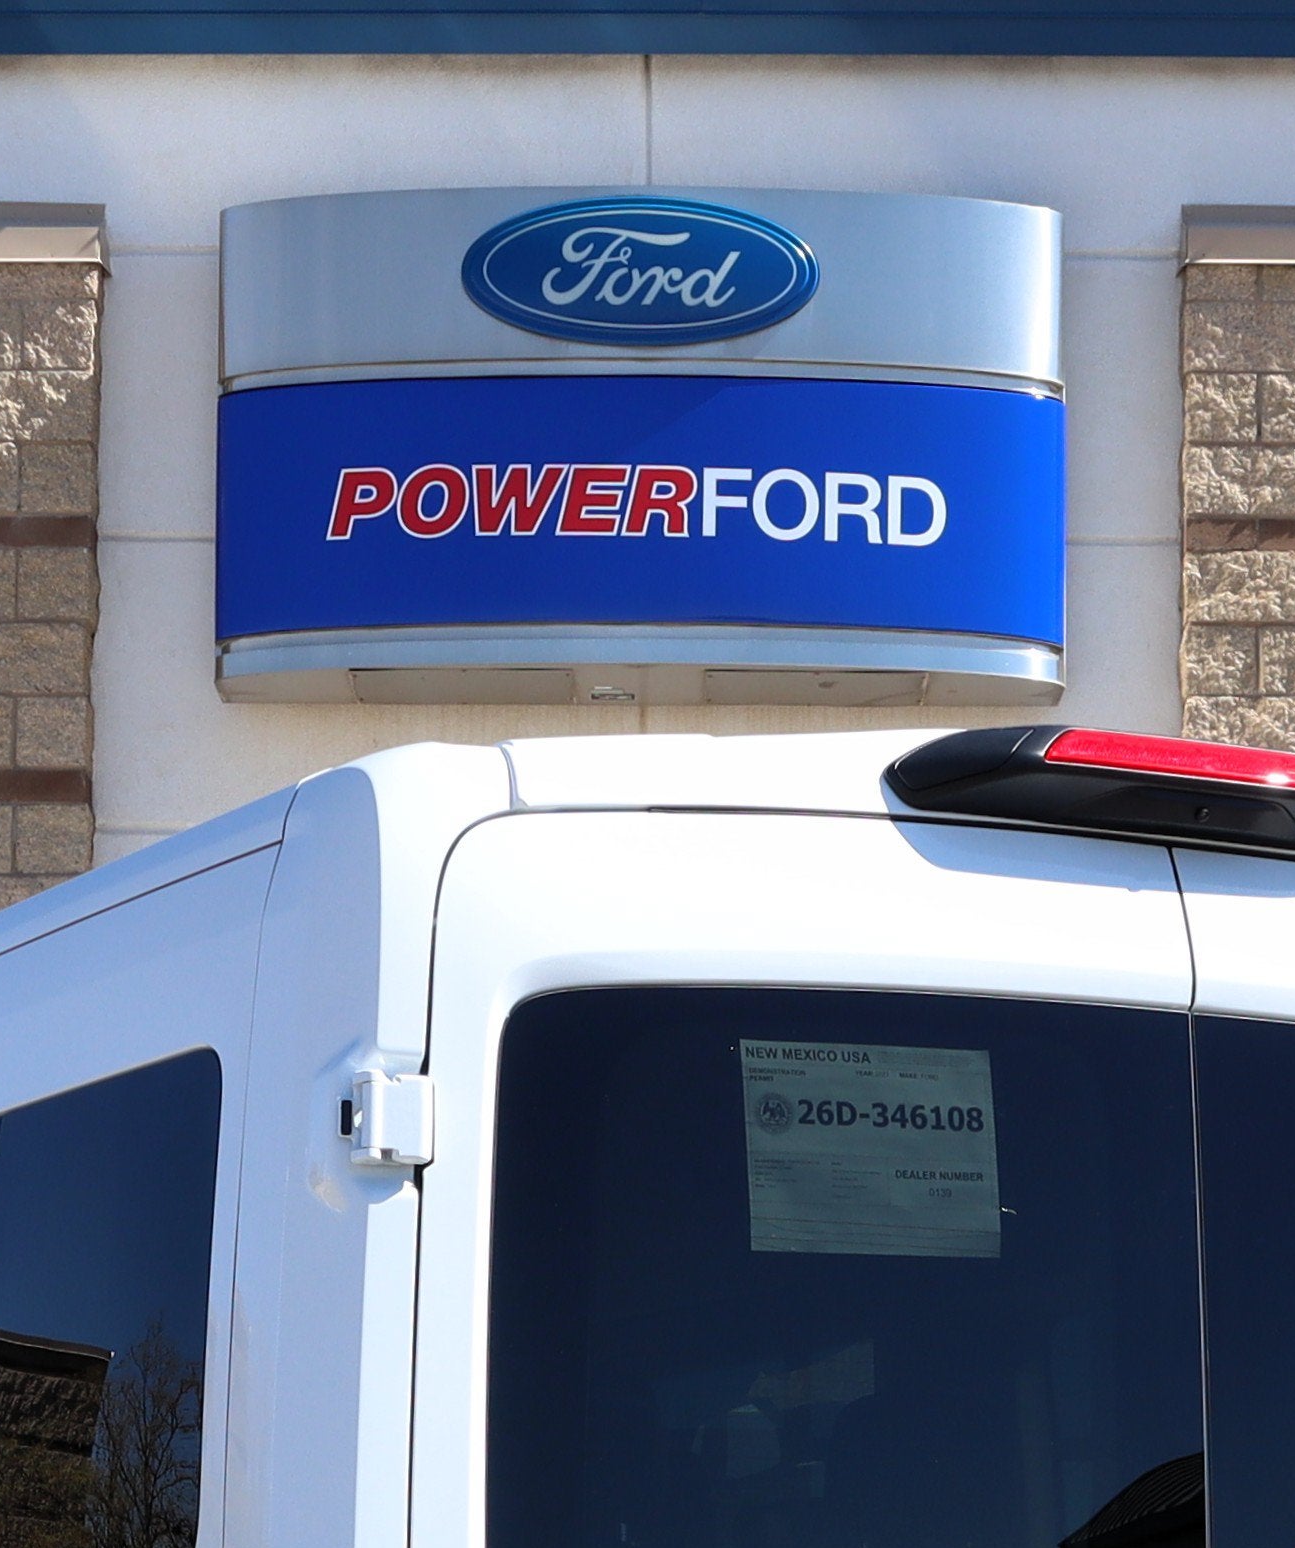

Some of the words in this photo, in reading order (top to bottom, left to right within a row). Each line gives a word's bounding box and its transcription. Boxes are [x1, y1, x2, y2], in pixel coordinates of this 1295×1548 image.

[541, 226, 740, 308] Ford
[325, 463, 947, 547] POWERFORD
[745, 1046, 778, 1060] NEW
[782, 1048, 838, 1063] MEXICO
[841, 1051, 871, 1065] USA
[797, 1098, 984, 1133] 26D-346108
[894, 1169, 936, 1181] DEALER
[939, 1171, 984, 1183] NUMBER
[928, 1187, 952, 1199] 0139
